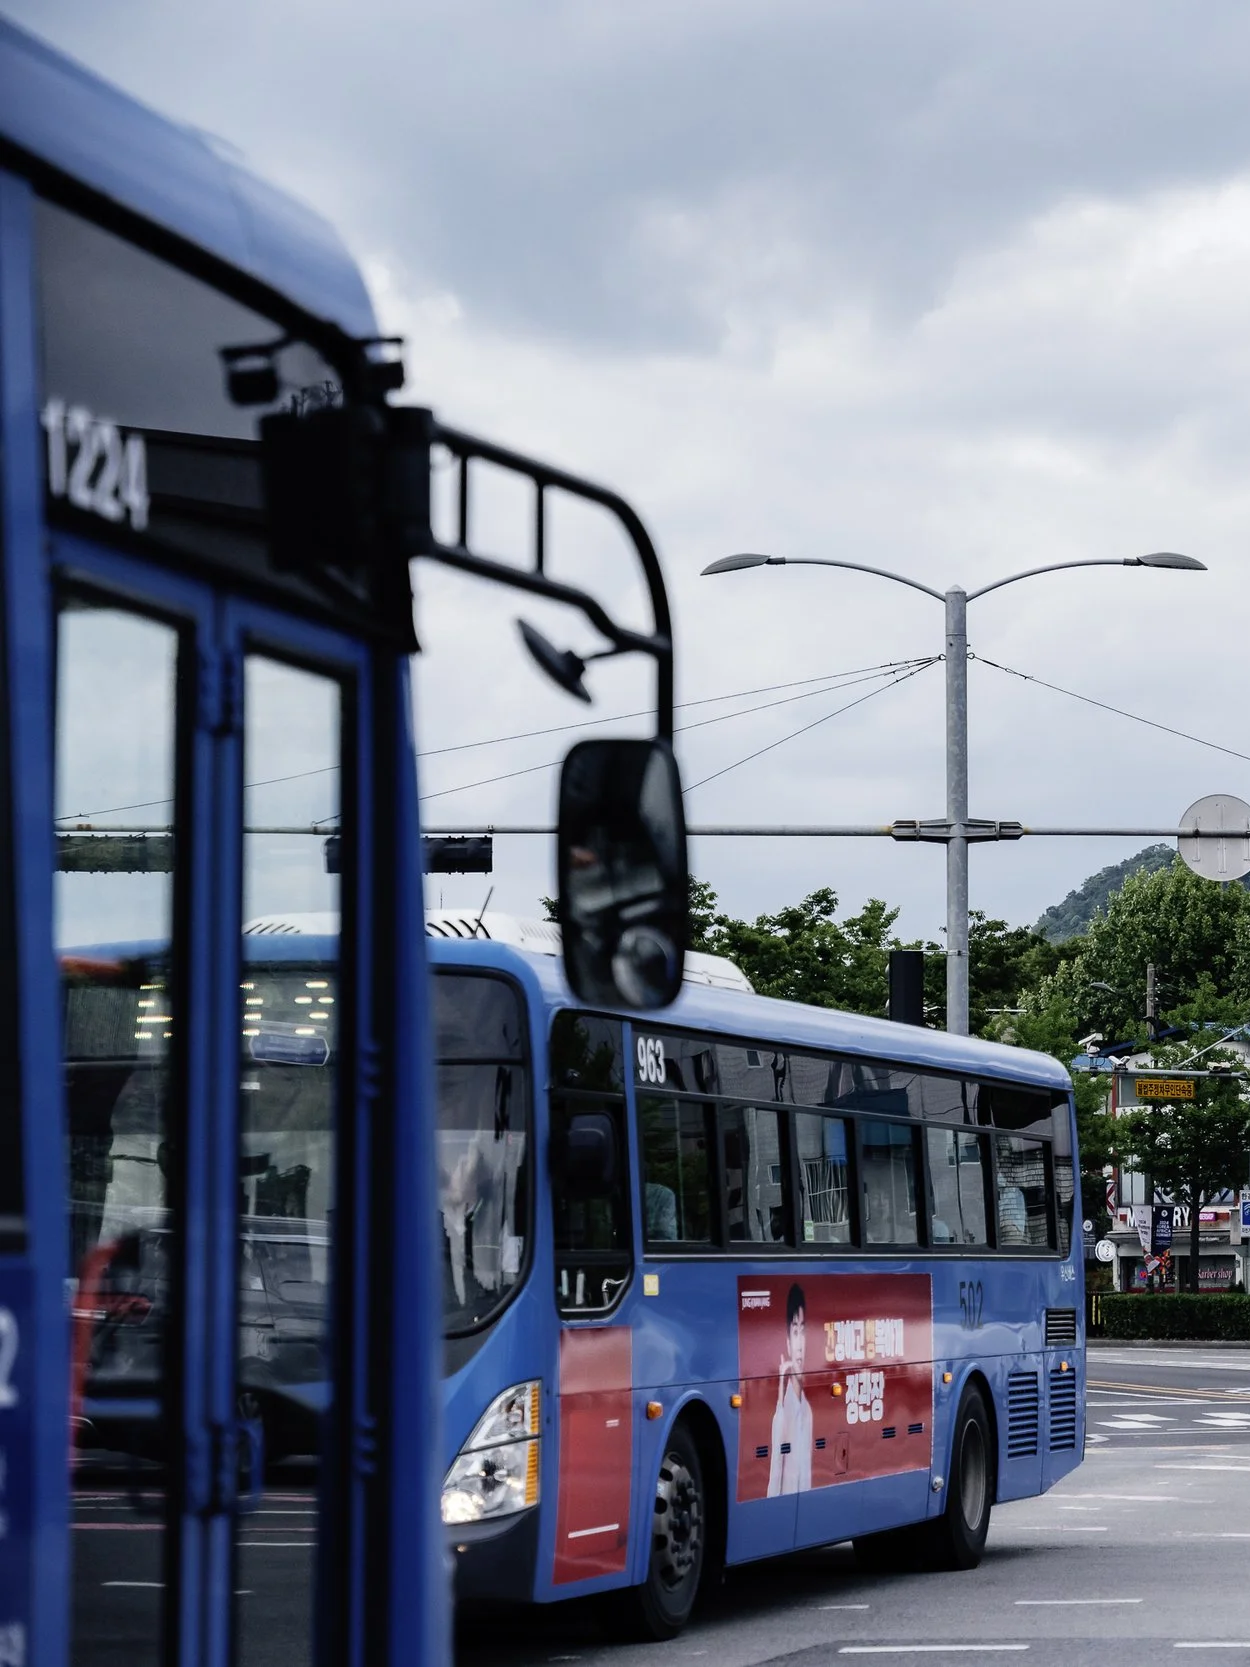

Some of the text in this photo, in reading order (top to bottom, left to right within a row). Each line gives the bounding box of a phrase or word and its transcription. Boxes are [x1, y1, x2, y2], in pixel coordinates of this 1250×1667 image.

[41, 398, 150, 530] 1224
[637, 1036, 666, 1084] 963
[1217, 1268, 1233, 1281] shop
[824, 1318, 904, 1362] 건강하고 행복하게
[845, 1369, 885, 1425] 정관장
